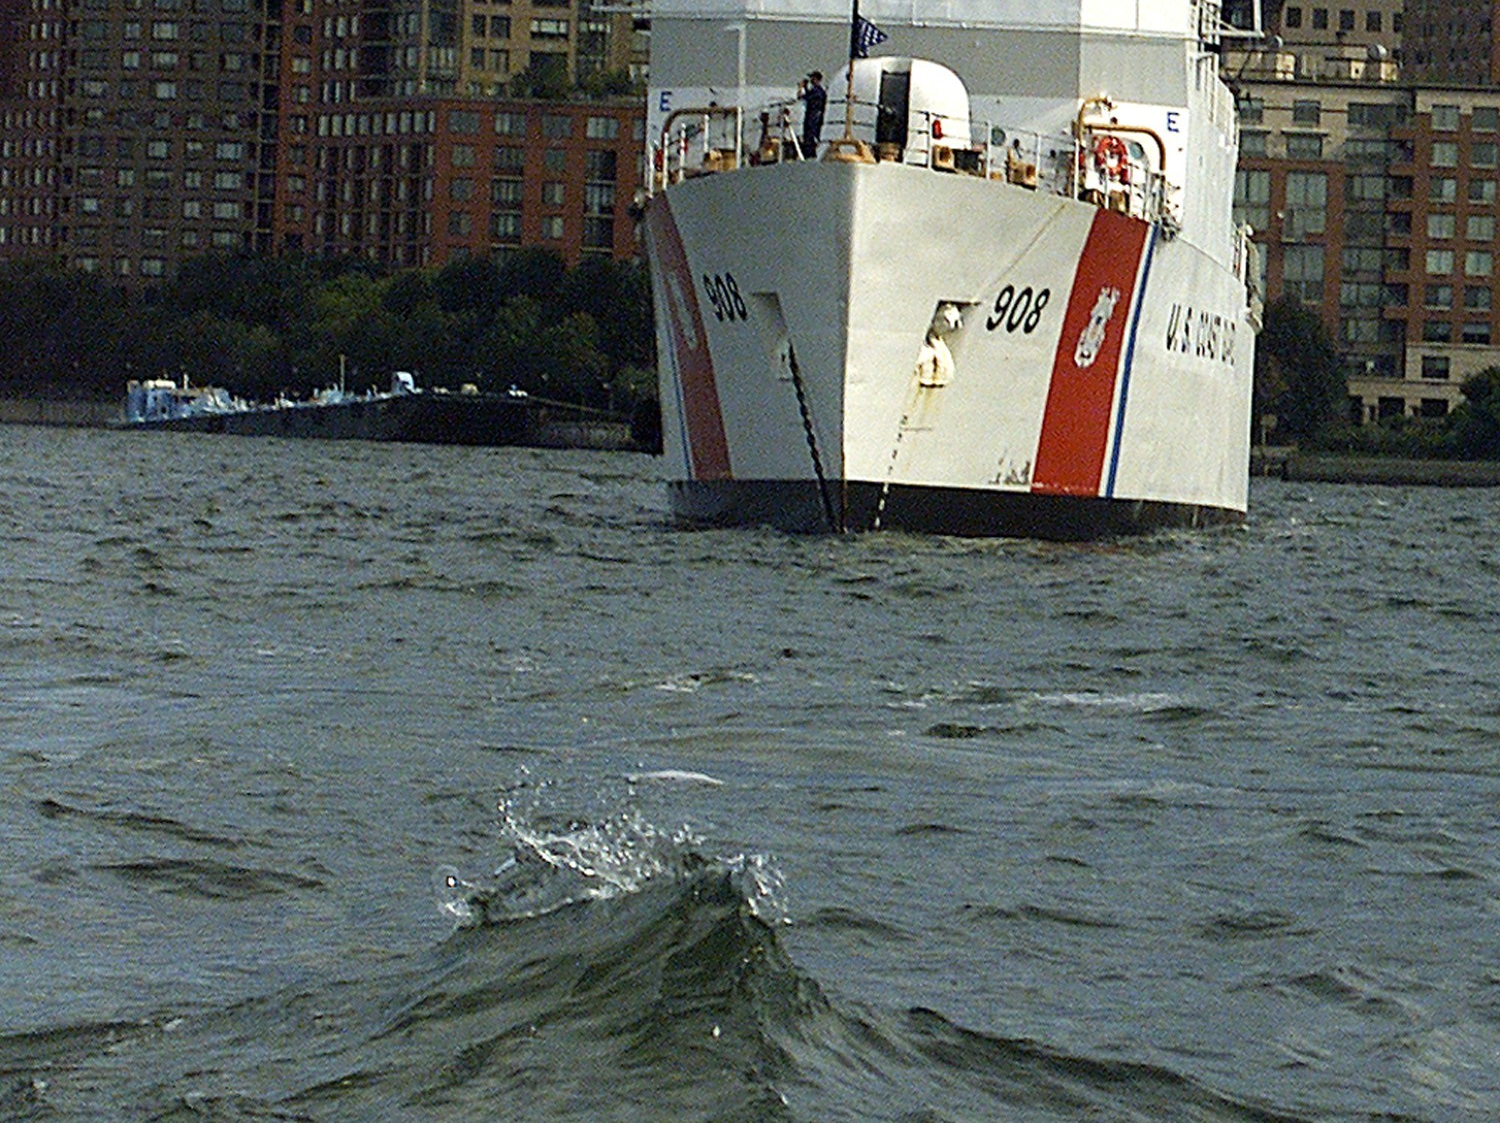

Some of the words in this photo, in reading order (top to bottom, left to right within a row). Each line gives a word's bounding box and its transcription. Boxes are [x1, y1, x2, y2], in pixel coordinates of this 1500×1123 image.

[660, 91, 672, 112] E
[1167, 112, 1180, 133] E
[703, 272, 748, 322] 908
[986, 284, 1051, 334] 908
